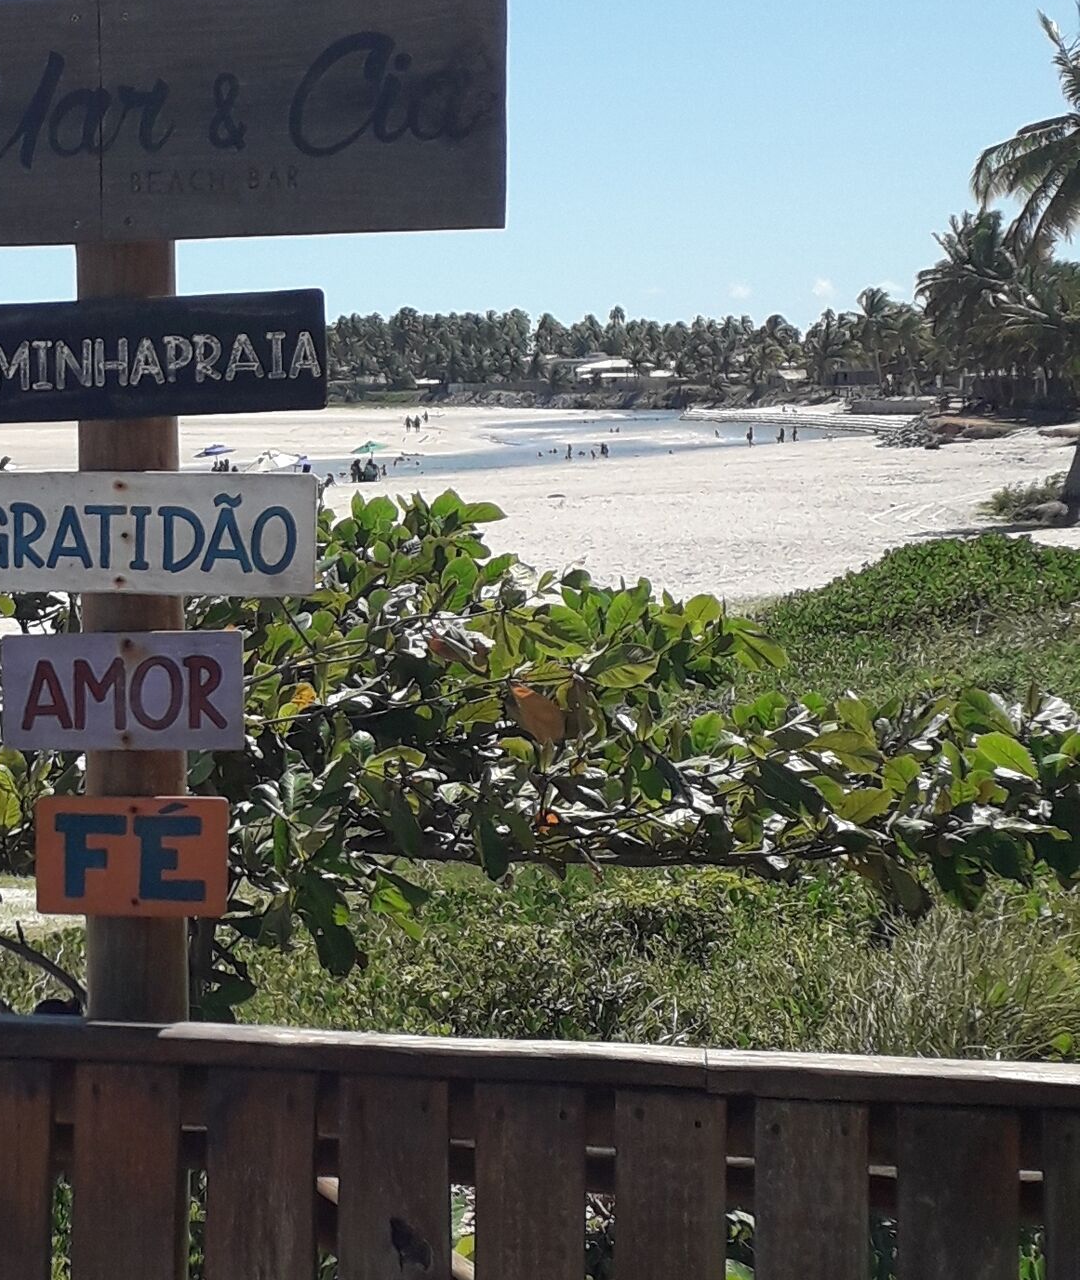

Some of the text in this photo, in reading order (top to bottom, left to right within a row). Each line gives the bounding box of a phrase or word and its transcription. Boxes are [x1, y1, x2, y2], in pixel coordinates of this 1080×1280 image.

[209, 71, 246, 150] &
[288, 29, 480, 158] Cia
[129, 164, 299, 194] BEACH BAR
[21, 654, 229, 731] AMOR
[53, 802, 207, 902] FÉ
